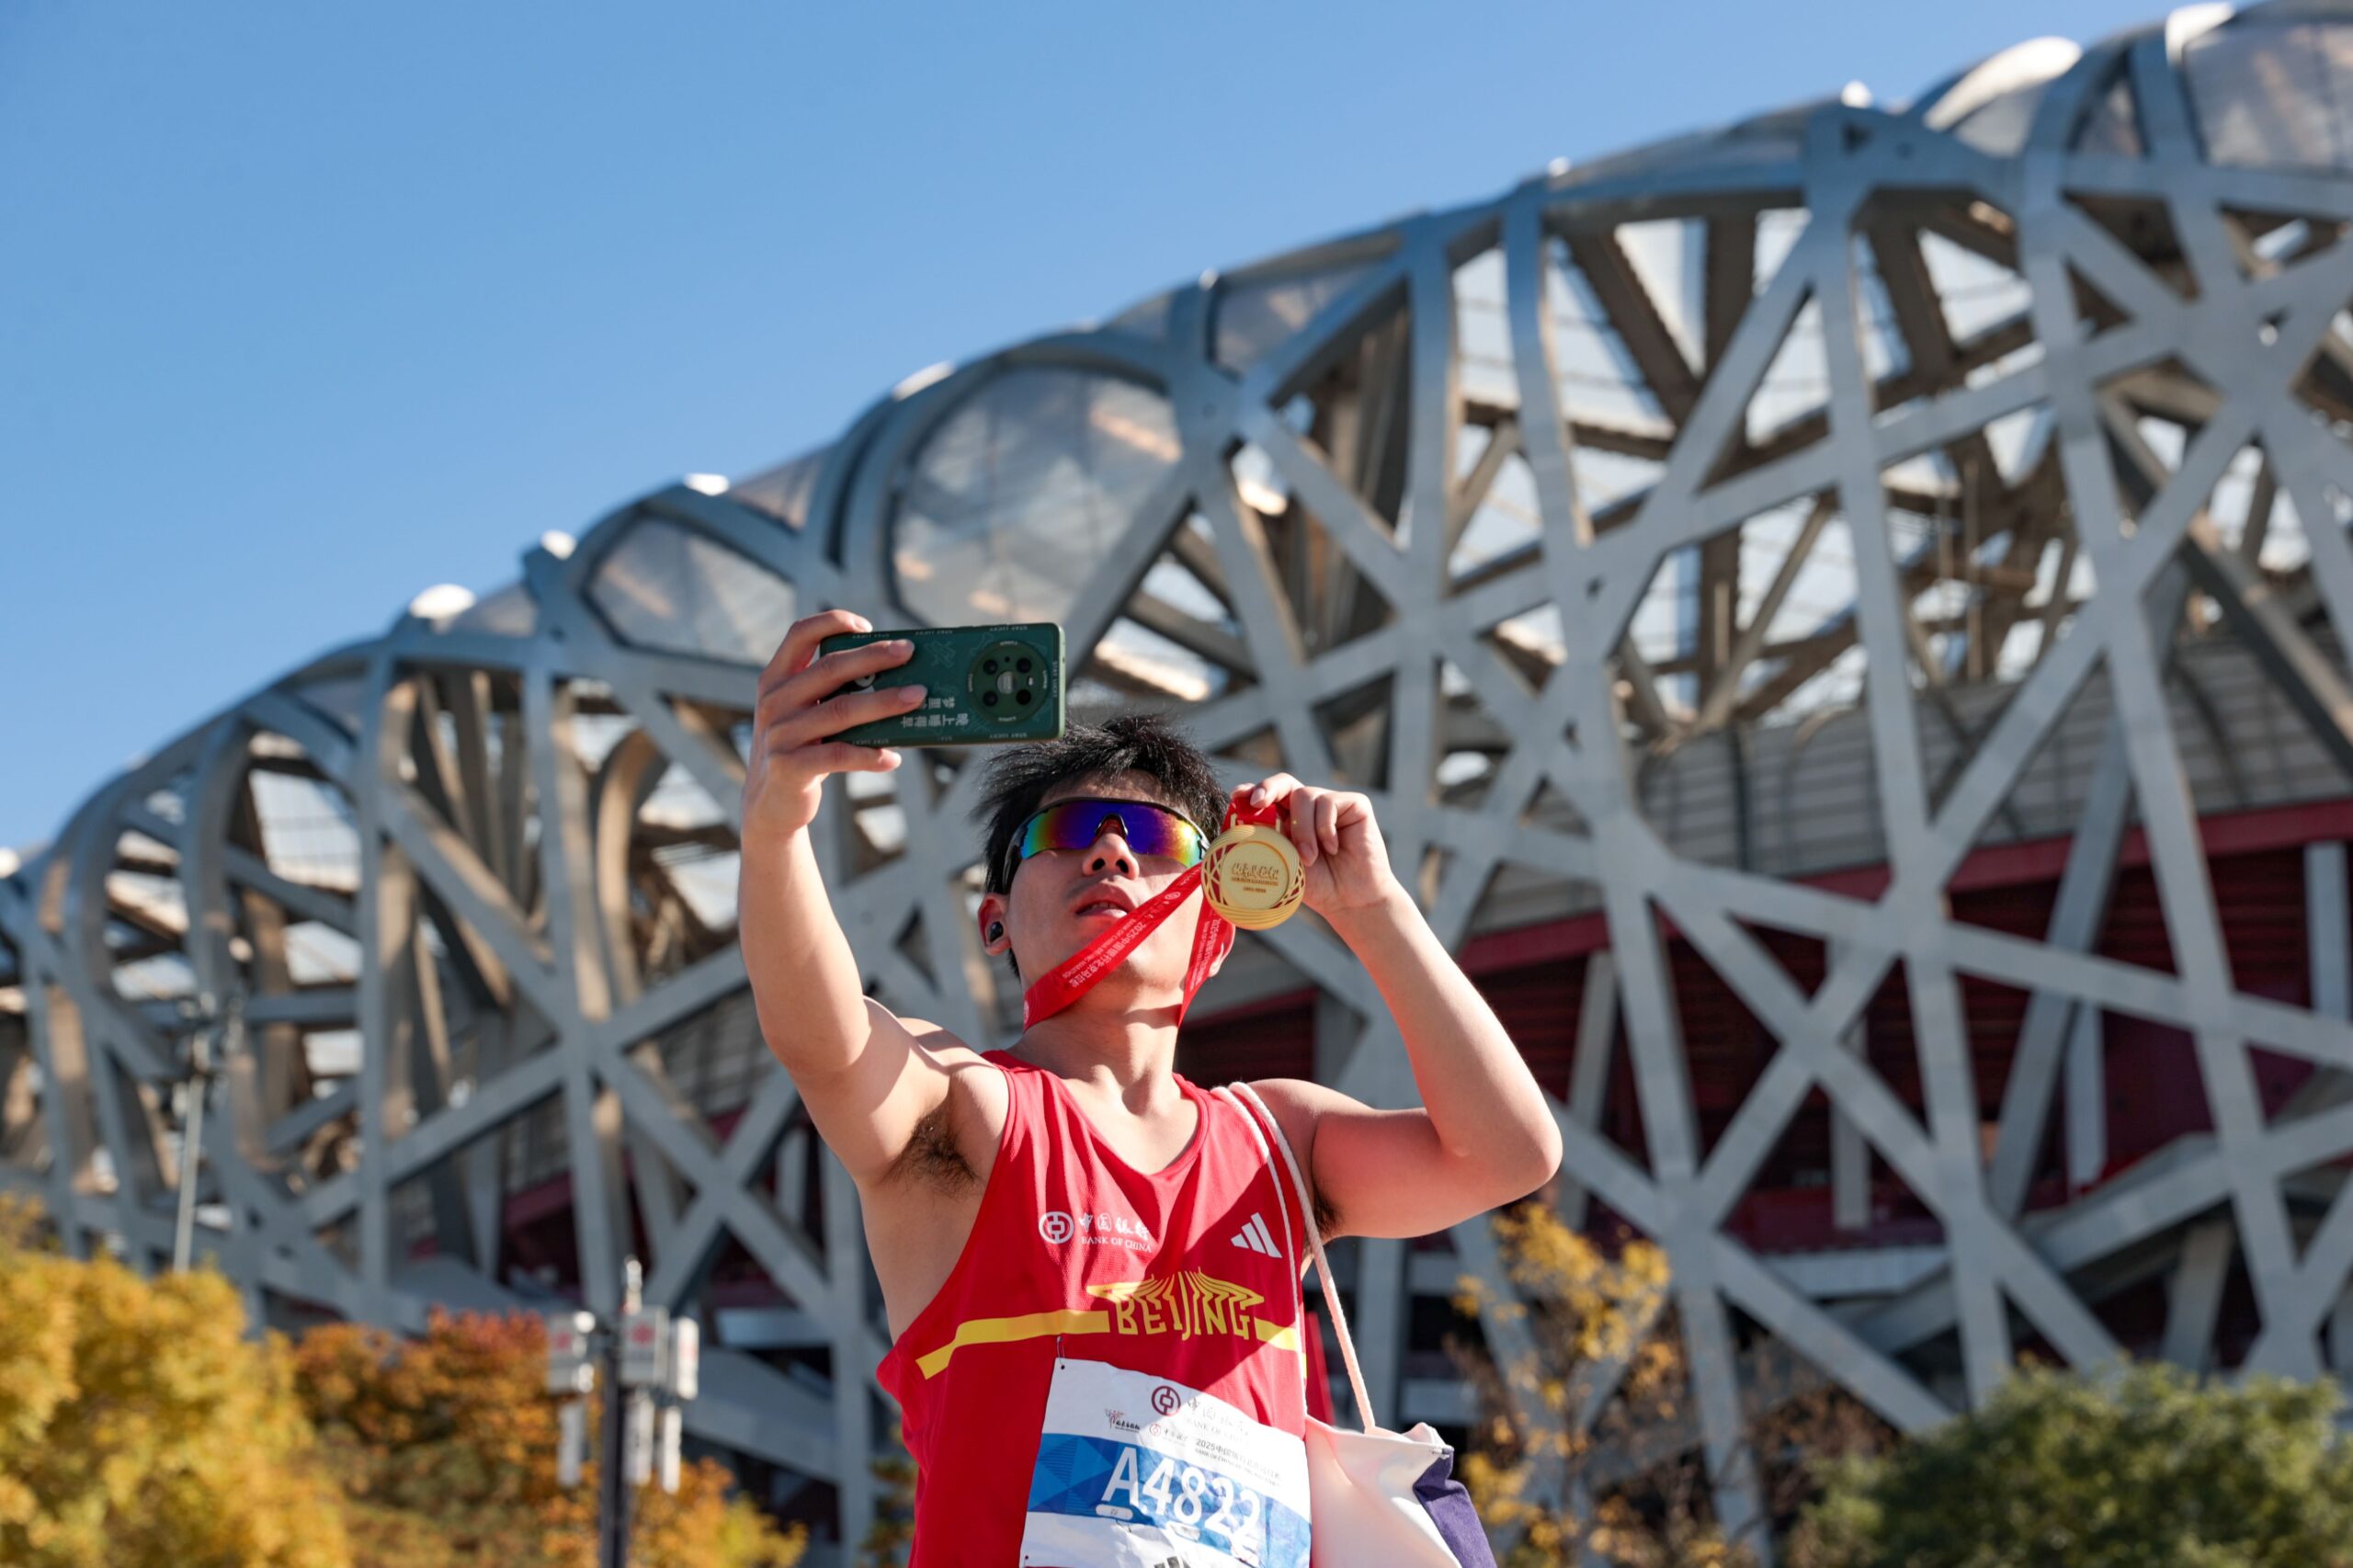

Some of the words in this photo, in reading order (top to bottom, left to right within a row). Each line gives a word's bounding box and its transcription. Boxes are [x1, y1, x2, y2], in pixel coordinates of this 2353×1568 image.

[1081, 1236, 1109, 1245] BANK
[1110, 1237, 1123, 1246] OF
[1124, 1239, 1152, 1253] CHINA
[1090, 1271, 1265, 1341] BEIJING
[1101, 1446, 1261, 1550] A4822
